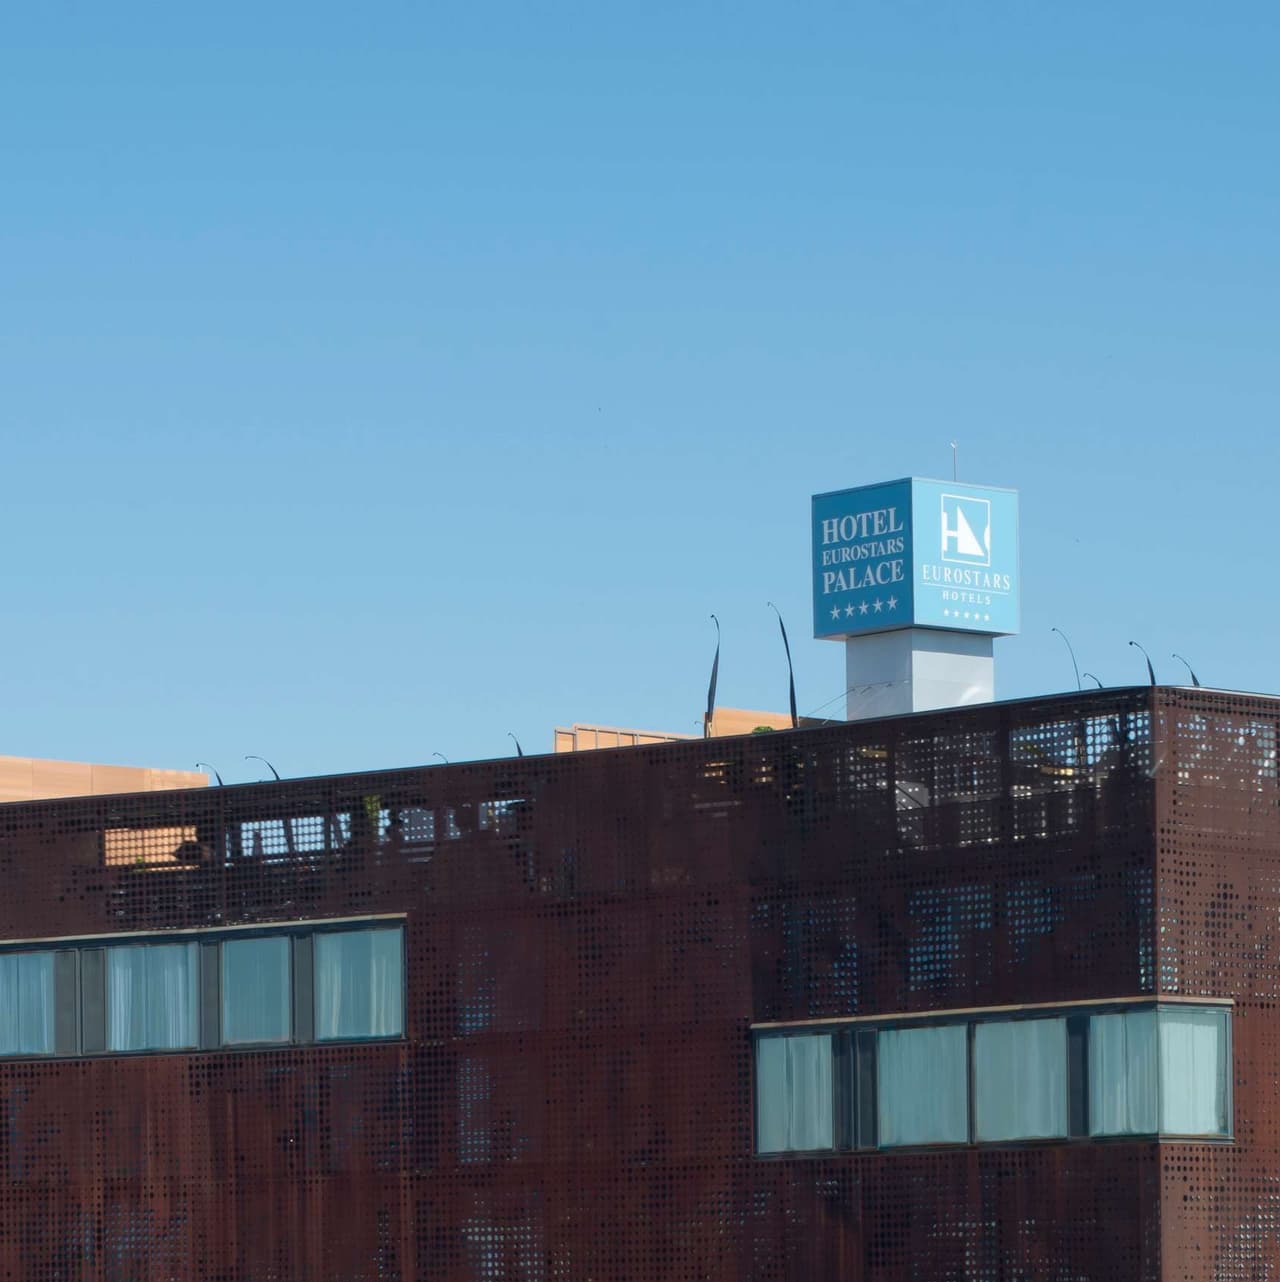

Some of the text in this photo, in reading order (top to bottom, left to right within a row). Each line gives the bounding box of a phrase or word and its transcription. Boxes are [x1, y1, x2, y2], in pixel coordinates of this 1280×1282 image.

[822, 507, 904, 544] HOTEL
[822, 536, 904, 566] EUROSTARS
[822, 559, 904, 594] PALACE
[922, 564, 1011, 590] EUROSTARS
[942, 591, 992, 606] HOTELS
